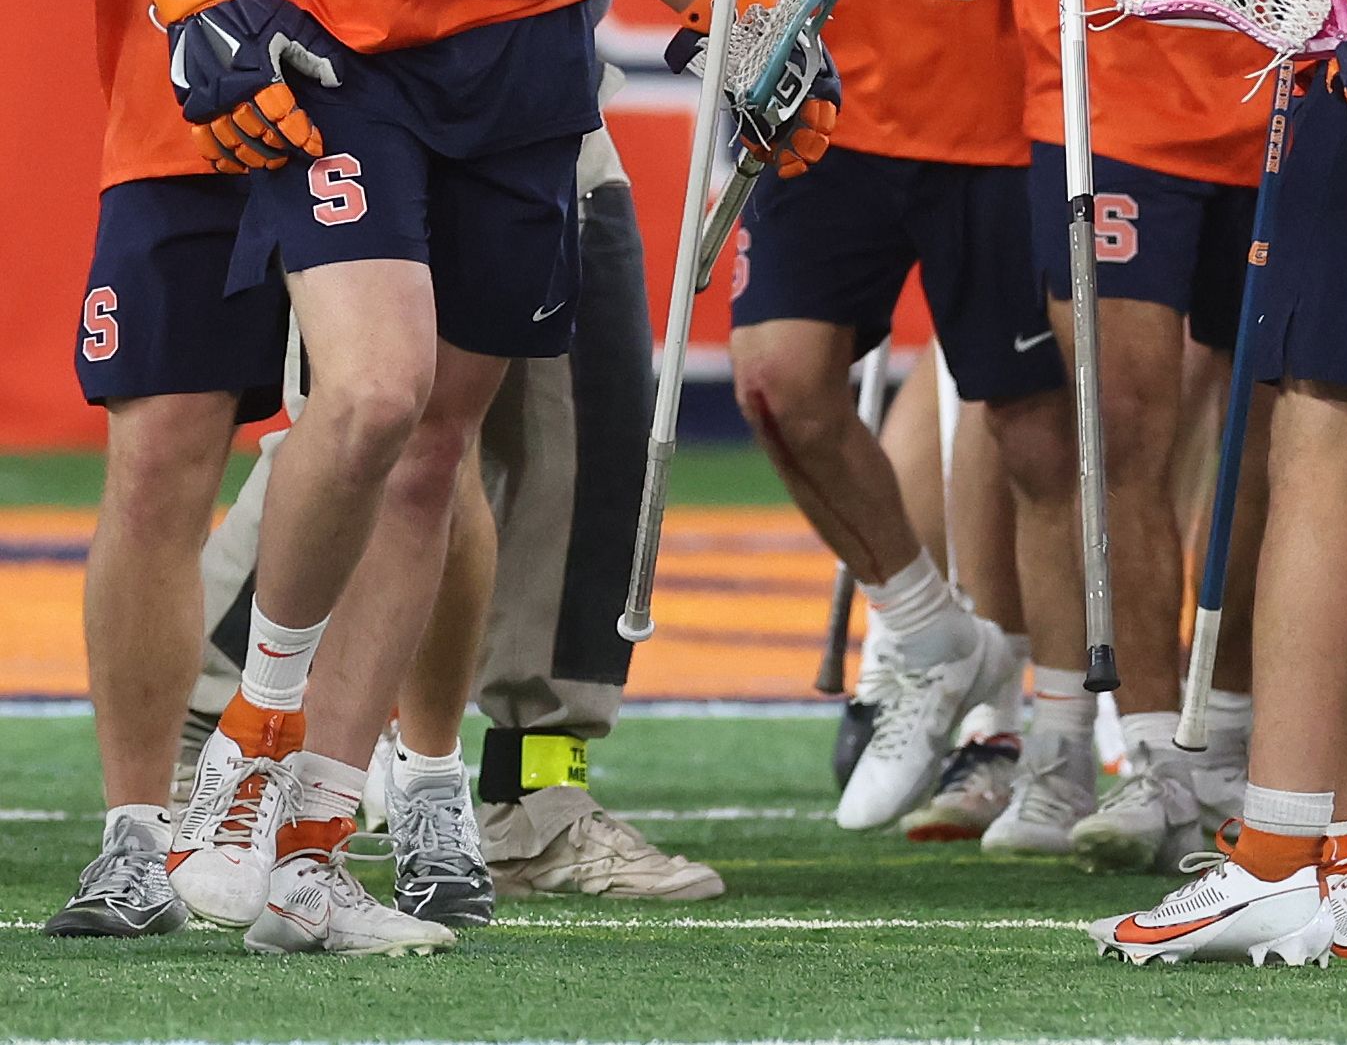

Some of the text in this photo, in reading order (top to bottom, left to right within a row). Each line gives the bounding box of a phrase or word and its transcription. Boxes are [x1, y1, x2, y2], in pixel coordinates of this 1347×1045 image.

[308, 152, 368, 227] S
[1094, 192, 1140, 264] S
[82, 285, 119, 362] S
